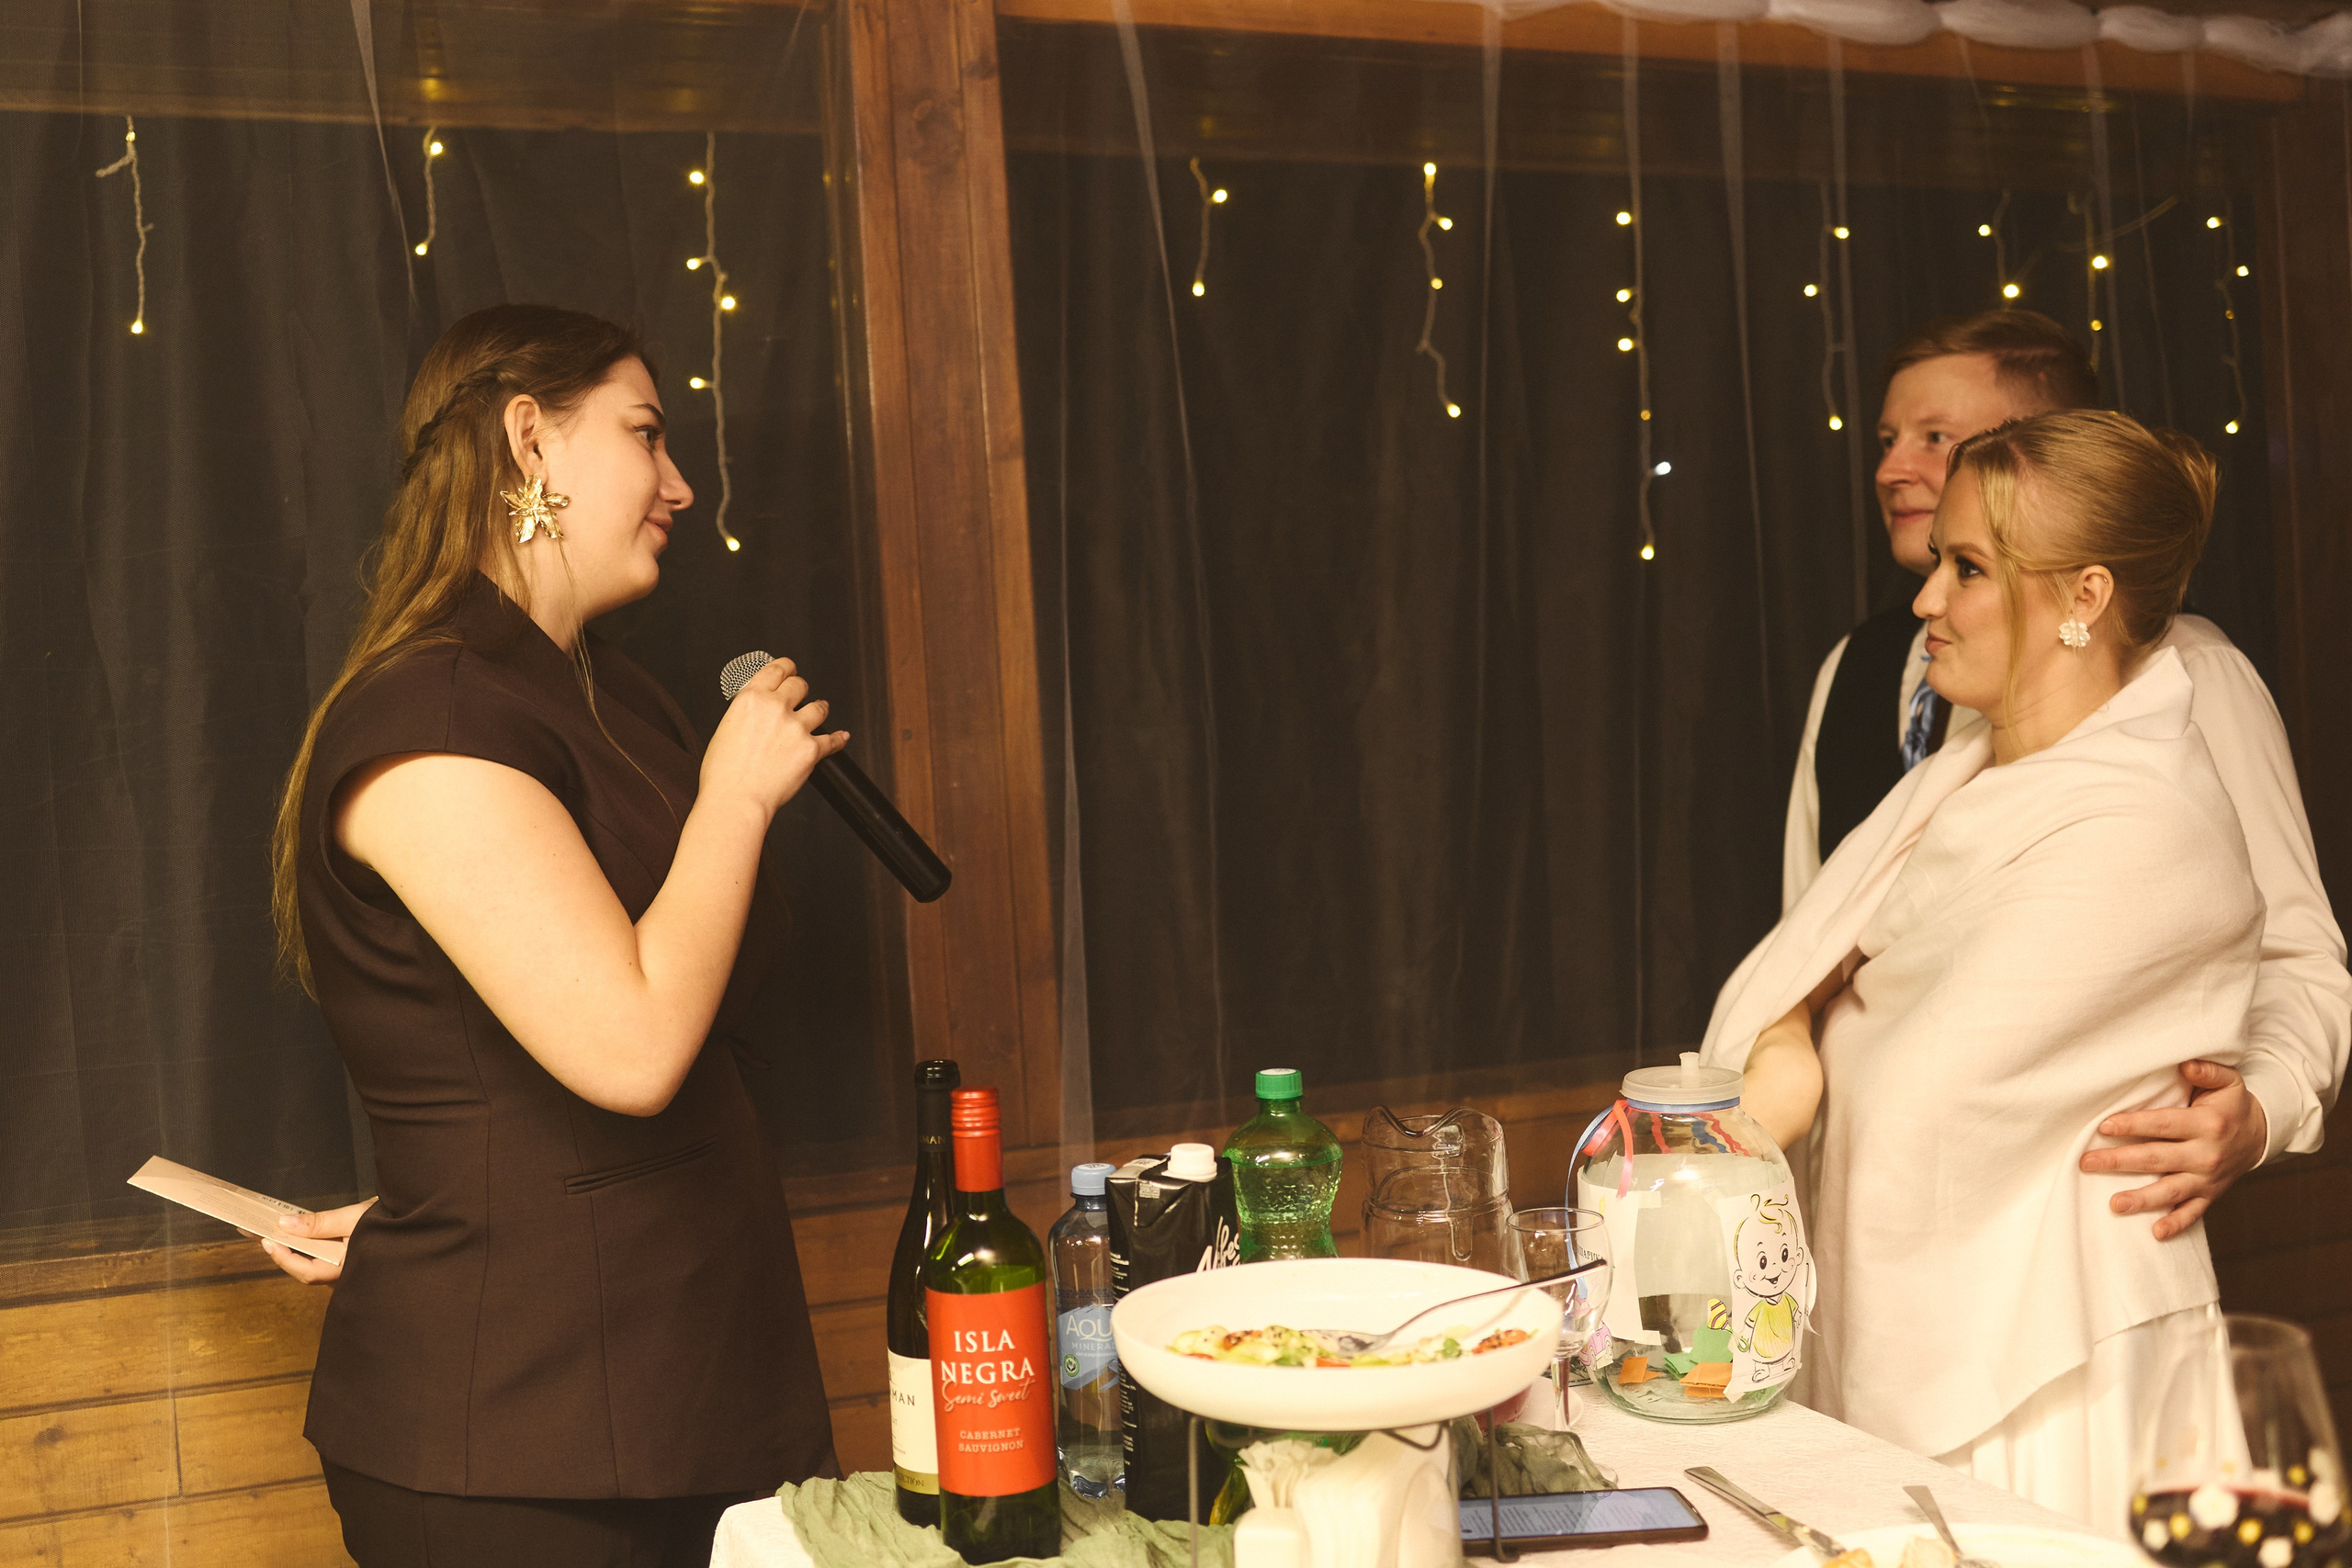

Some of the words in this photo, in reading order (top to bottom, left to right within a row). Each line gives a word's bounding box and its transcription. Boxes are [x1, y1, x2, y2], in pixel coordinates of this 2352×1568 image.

[954, 1329, 1016, 1353] ISLA
[941, 1357, 1035, 1385] NEGRA
[942, 1379, 985, 1412] Semi
[959, 1427, 1021, 1440] CABERNET
[958, 1439, 1024, 1453] SAUVIGNON
